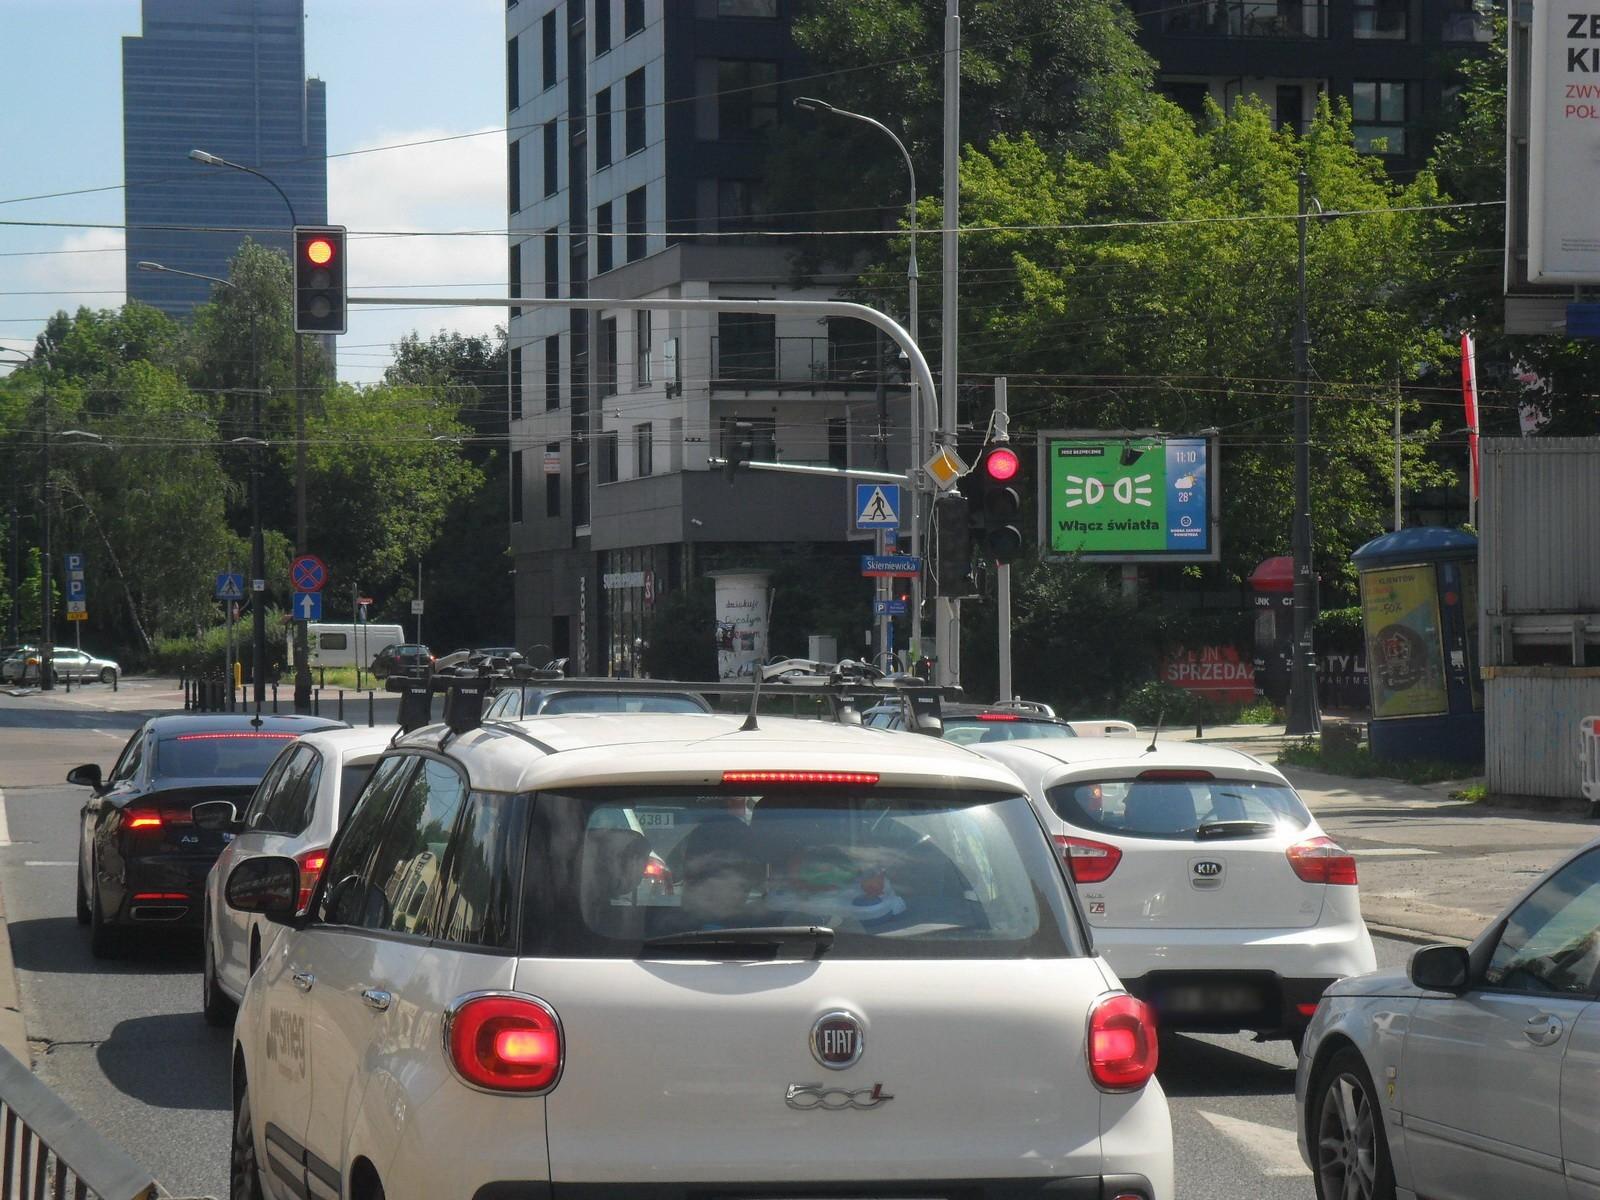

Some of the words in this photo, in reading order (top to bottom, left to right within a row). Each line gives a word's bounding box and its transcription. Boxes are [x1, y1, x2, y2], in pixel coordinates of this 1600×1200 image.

[1176, 451, 1196, 463] 11:10
[1058, 520, 1104, 534] Włącz
[1107, 518, 1160, 531] światła
[866, 560, 916, 571] Skierniewicka
[1197, 863, 1219, 874] KIA
[823, 1029, 854, 1055] FIAT
